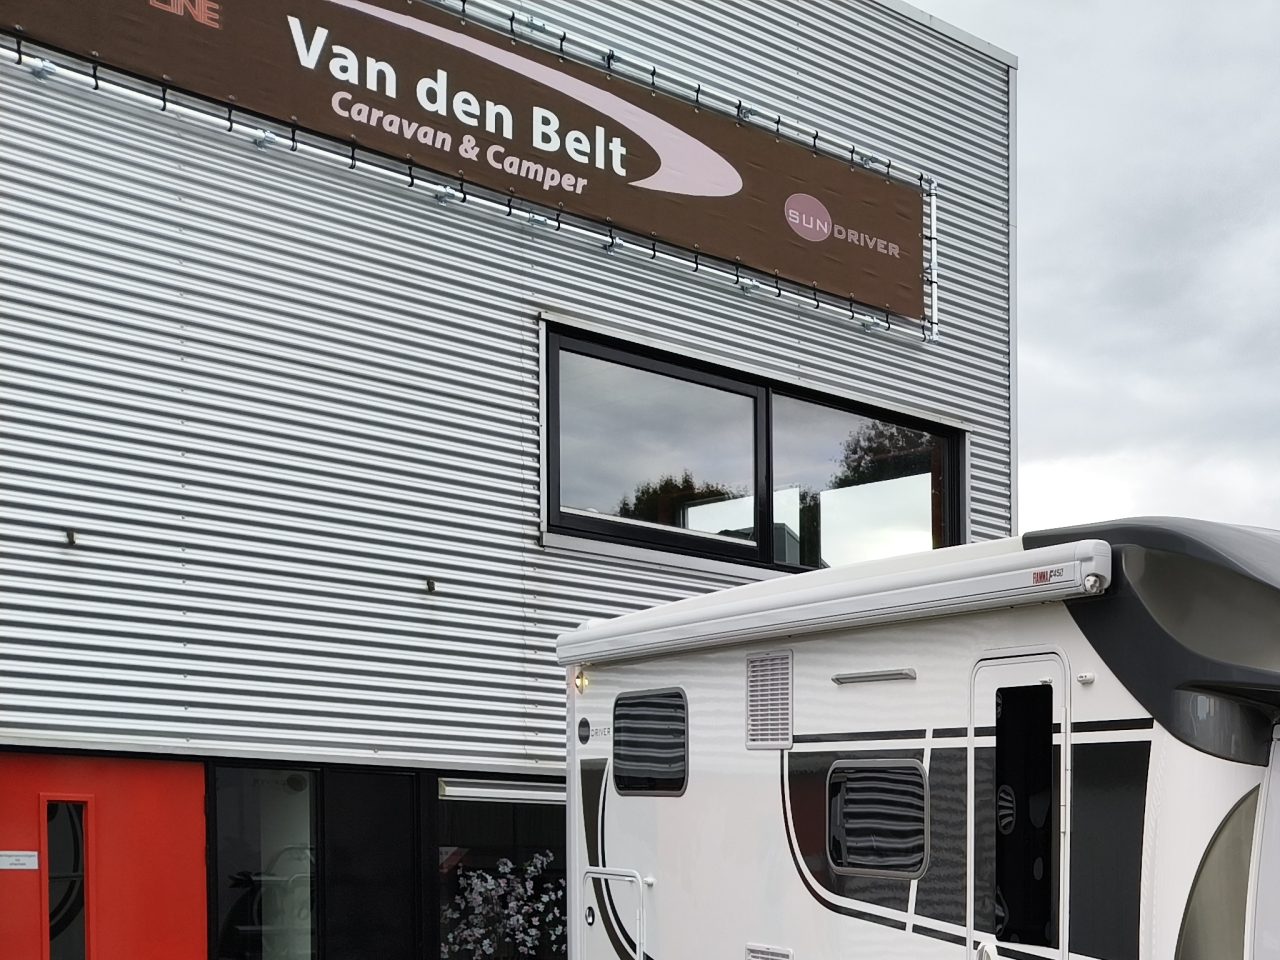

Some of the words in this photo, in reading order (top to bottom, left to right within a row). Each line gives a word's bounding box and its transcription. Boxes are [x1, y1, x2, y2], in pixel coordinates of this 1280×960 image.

[287, 15, 397, 99] Van
[416, 69, 513, 140] den
[532, 106, 627, 176] Belt
[331, 91, 451, 152] Caravan
[458, 134, 479, 161] &
[486, 145, 588, 194] Camper
[788, 209, 828, 234] SUN
[833, 224, 900, 259] DRIVER
